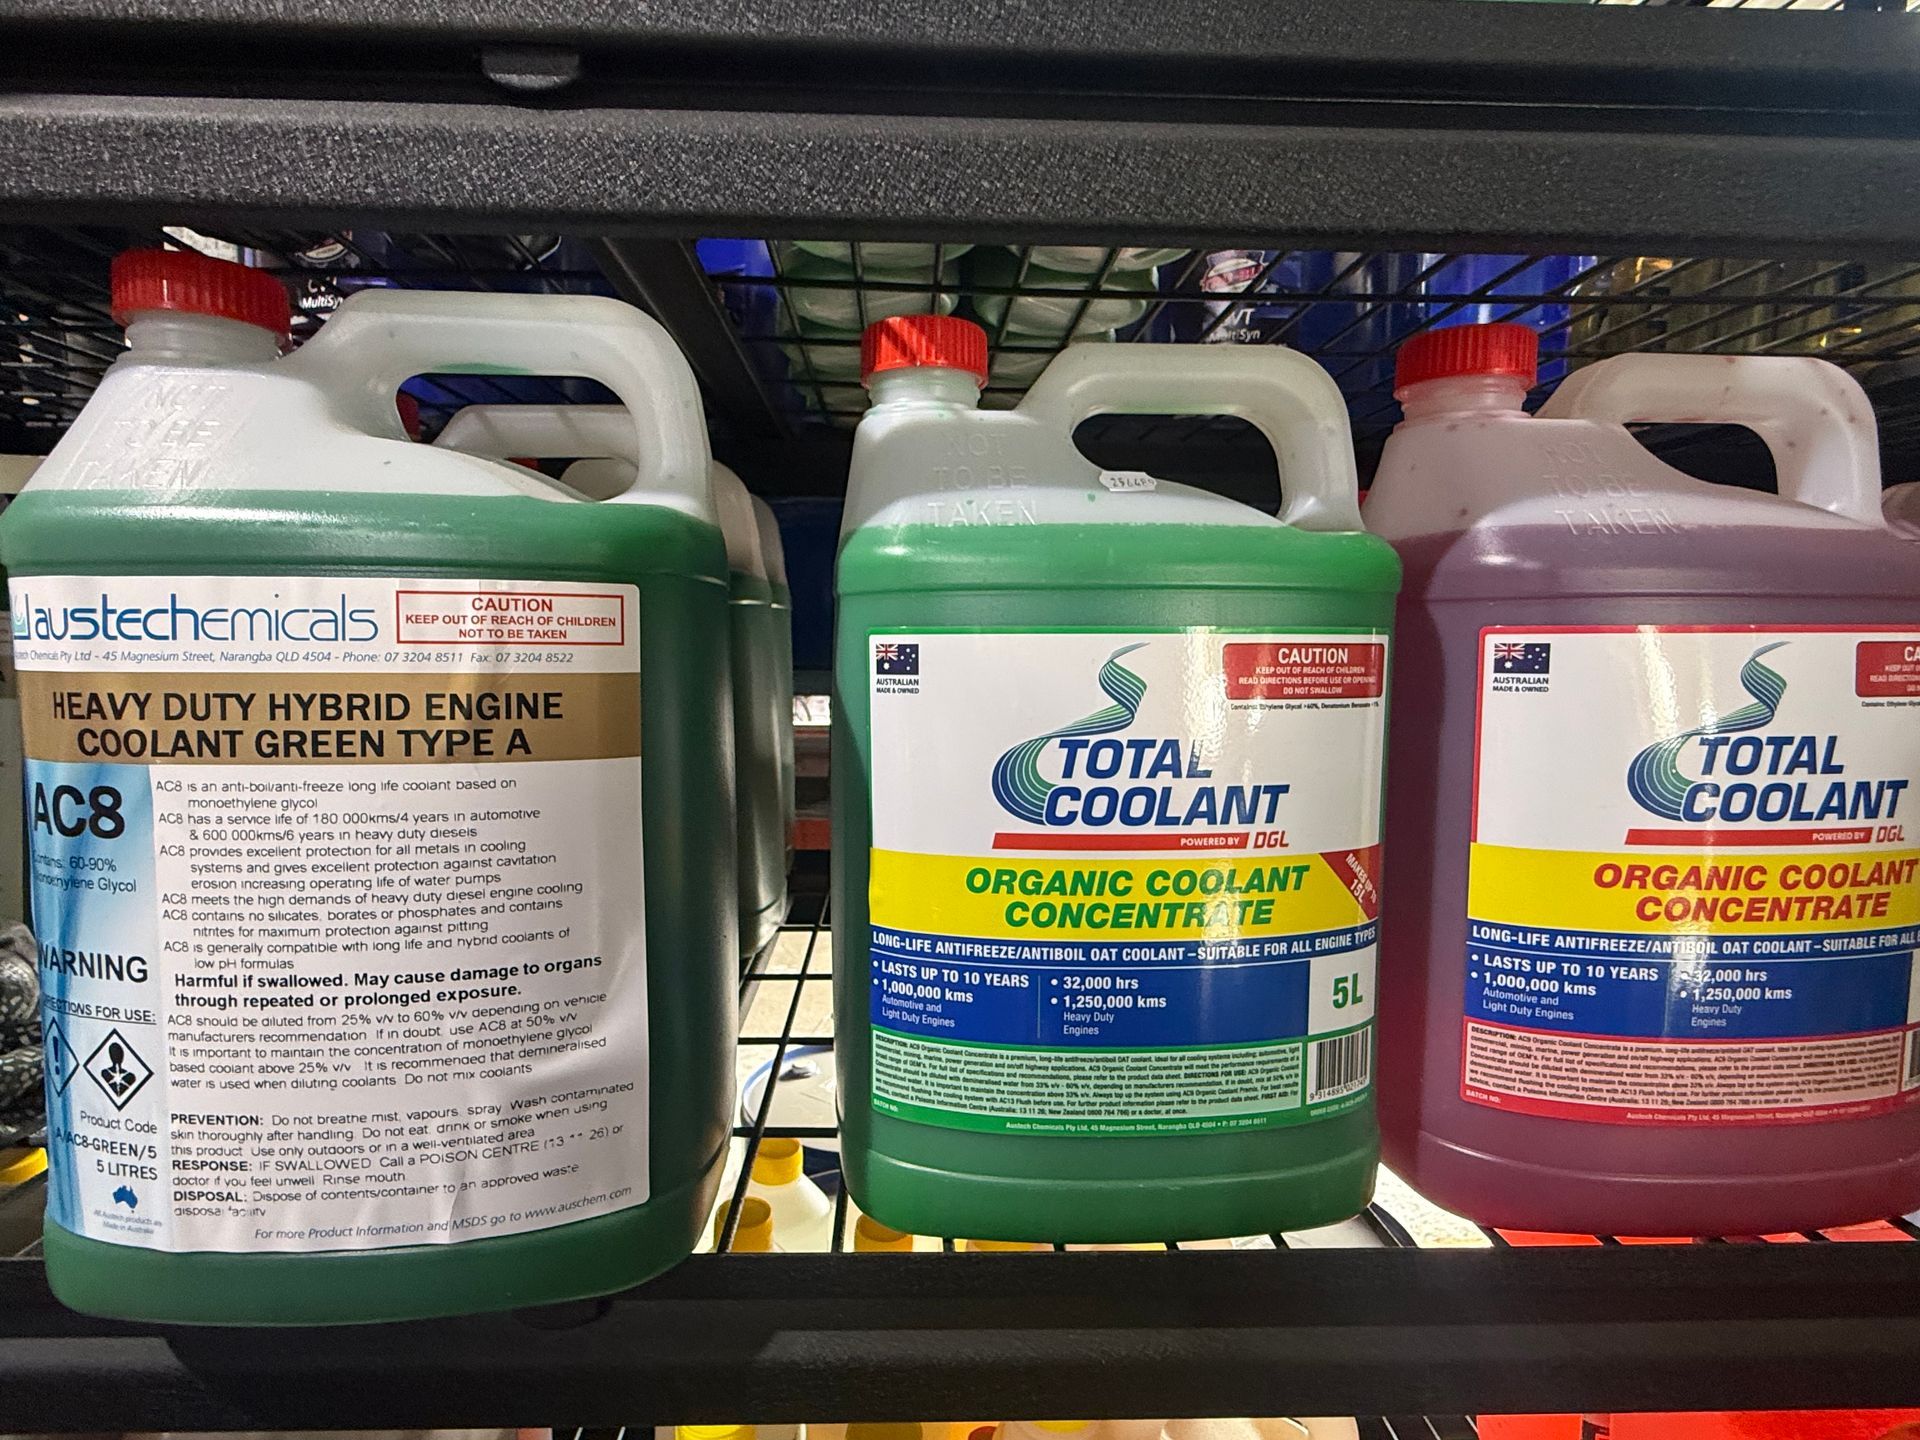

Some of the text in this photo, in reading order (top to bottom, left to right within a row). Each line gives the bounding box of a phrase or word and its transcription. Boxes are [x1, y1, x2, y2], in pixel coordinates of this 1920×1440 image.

[927, 500, 1038, 527] TAKEN
[471, 597, 553, 612] CAUTION
[405, 614, 616, 627] KEEP OUT OF REACH OF CHILDREN
[458, 629, 567, 640] NOT TO BE TAKEN
[74, 650, 92, 661] Ltd
[102, 650, 118, 662] 45
[120, 650, 179, 664] Magnesium
[182, 651, 215, 664] Street,
[219, 651, 273, 664] Narangba
[276, 652, 300, 662] QLD
[302, 652, 331, 662] 4504
[342, 652, 381, 663] Phone:
[384, 653, 399, 663] 07
[402, 653, 431, 663] 3204
[434, 653, 463, 663] 8511
[496, 653, 511, 663] 07
[513, 653, 542, 663] 3204
[545, 653, 574, 663] 8522
[1278, 648, 1349, 664] CAUTION
[876, 678, 919, 687] AUSTRALIAN
[897, 687, 920, 695] OWNED
[1492, 676, 1549, 686] AUSTRALIAN
[52, 691, 564, 722] HEAVY DUTY HYBRID ENGINE
[77, 729, 533, 758] COOLANT GREEN TYPE A
[1058, 738, 1213, 780] TOTAL
[1699, 735, 1845, 776] TOTAL
[156, 780, 183, 792] AC8
[187, 782, 197, 792] is
[201, 782, 217, 792] an
[348, 780, 377, 793] long
[380, 780, 399, 791] life
[402, 780, 451, 791] coolant
[456, 778, 497, 790] based
[500, 778, 517, 789] on
[34, 782, 126, 839] AC8
[1045, 784, 1291, 827] COOLANT
[1682, 779, 1909, 823] COOLANT
[1180, 830, 1290, 849] POWERED BY DGL
[1812, 825, 1905, 843] POWERED BY DGL
[69, 855, 117, 873] 60-90%
[1345, 852, 1368, 884] MAKES
[1593, 858, 1919, 891] ORGANIC COOLANT
[98, 877, 137, 895] Glycol
[965, 864, 1310, 897] ORGANIC COOLANT
[1350, 878, 1366, 904] 15L
[1004, 899, 1276, 930] CONCENTRATE
[1635, 892, 1892, 923] CONCENTRATE
[872, 930, 932, 953] LONG-LIFE
[935, 941, 1087, 962] ANTIFREEZE/ANTIBOIL
[1090, 948, 1118, 962] OAT
[1122, 947, 1185, 962] COOLANT
[1263, 942, 1288, 957] FOR
[1291, 939, 1313, 954] ALL
[1315, 934, 1353, 951] ENGINE
[1354, 926, 1376, 945] TYPES
[1472, 925, 1550, 947] LONG-LIFE
[1554, 935, 1719, 954] ANTIFREEZE/ANTIBOIL
[1722, 941, 1750, 954] OAT
[1753, 940, 1813, 954] COOLANT
[1878, 934, 1899, 948] FOR
[1899, 932, 1916, 946] ALL
[174, 956, 603, 989] Harmful if swallowed. May cause damage to organs
[881, 960, 1030, 988] LASTS UP TO 10 YEARS
[1483, 954, 1659, 982] LASTS UP TO 10 YEARS
[1693, 968, 1768, 984] 32,000 hrs
[881, 978, 974, 1003] 1,000,000 kms
[1062, 976, 1139, 991] 32,000 hrs
[1332, 972, 1364, 1009] 5L
[1483, 972, 1597, 997] 1,000,000 kms
[174, 985, 522, 1010] through repeated or prolonged exposure.
[882, 995, 942, 1013] Automotive and
[1063, 994, 1167, 1010] 1,250,000 kms
[1482, 987, 1559, 1005] Automotive and
[1692, 987, 1793, 1003] 1,250,000 kms
[95, 1006, 121, 1020] FOR
[124, 1008, 156, 1022] USE:
[882, 1006, 956, 1028] Light Duty Engines
[1063, 1011, 1115, 1023] Heavy Duty
[1482, 999, 1575, 1021] Light Duty Engines
[1692, 1003, 1743, 1015] Heavy Duty
[1063, 1025, 1100, 1036] Engines
[1691, 1017, 1727, 1029] Engines
[80, 1111, 158, 1134] Product Code
[96, 1159, 158, 1181] 5 LITRES
